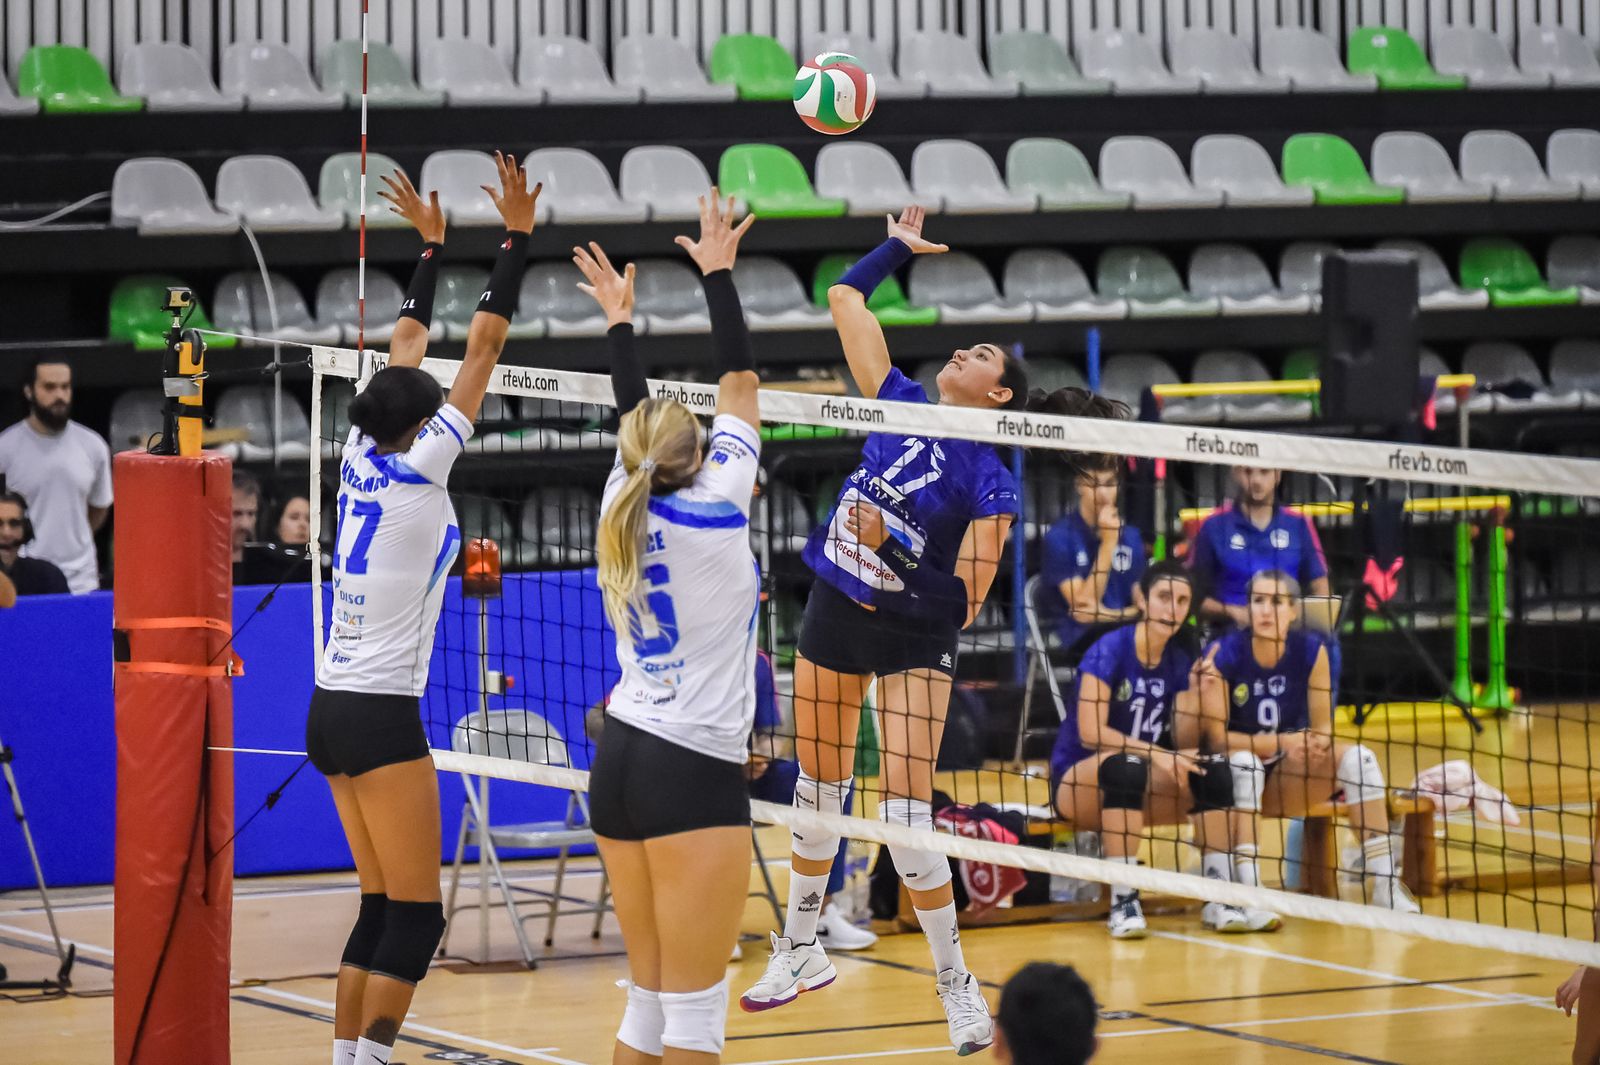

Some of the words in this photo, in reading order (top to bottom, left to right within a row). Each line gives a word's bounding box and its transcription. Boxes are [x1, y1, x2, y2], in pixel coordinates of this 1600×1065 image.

[502, 369, 559, 391] rfevb.com
[656, 384, 716, 407] rfevb.com
[821, 400, 884, 423] rfevb.com
[996, 415, 1065, 440] rfevb.com
[1186, 432, 1259, 457] rfevb.com
[1388, 449, 1468, 475] rfevb.com
[332, 492, 383, 575] 17
[836, 539, 896, 582] TotalEnergies
[1129, 696, 1165, 743] 14
[1257, 698, 1279, 735] 9
